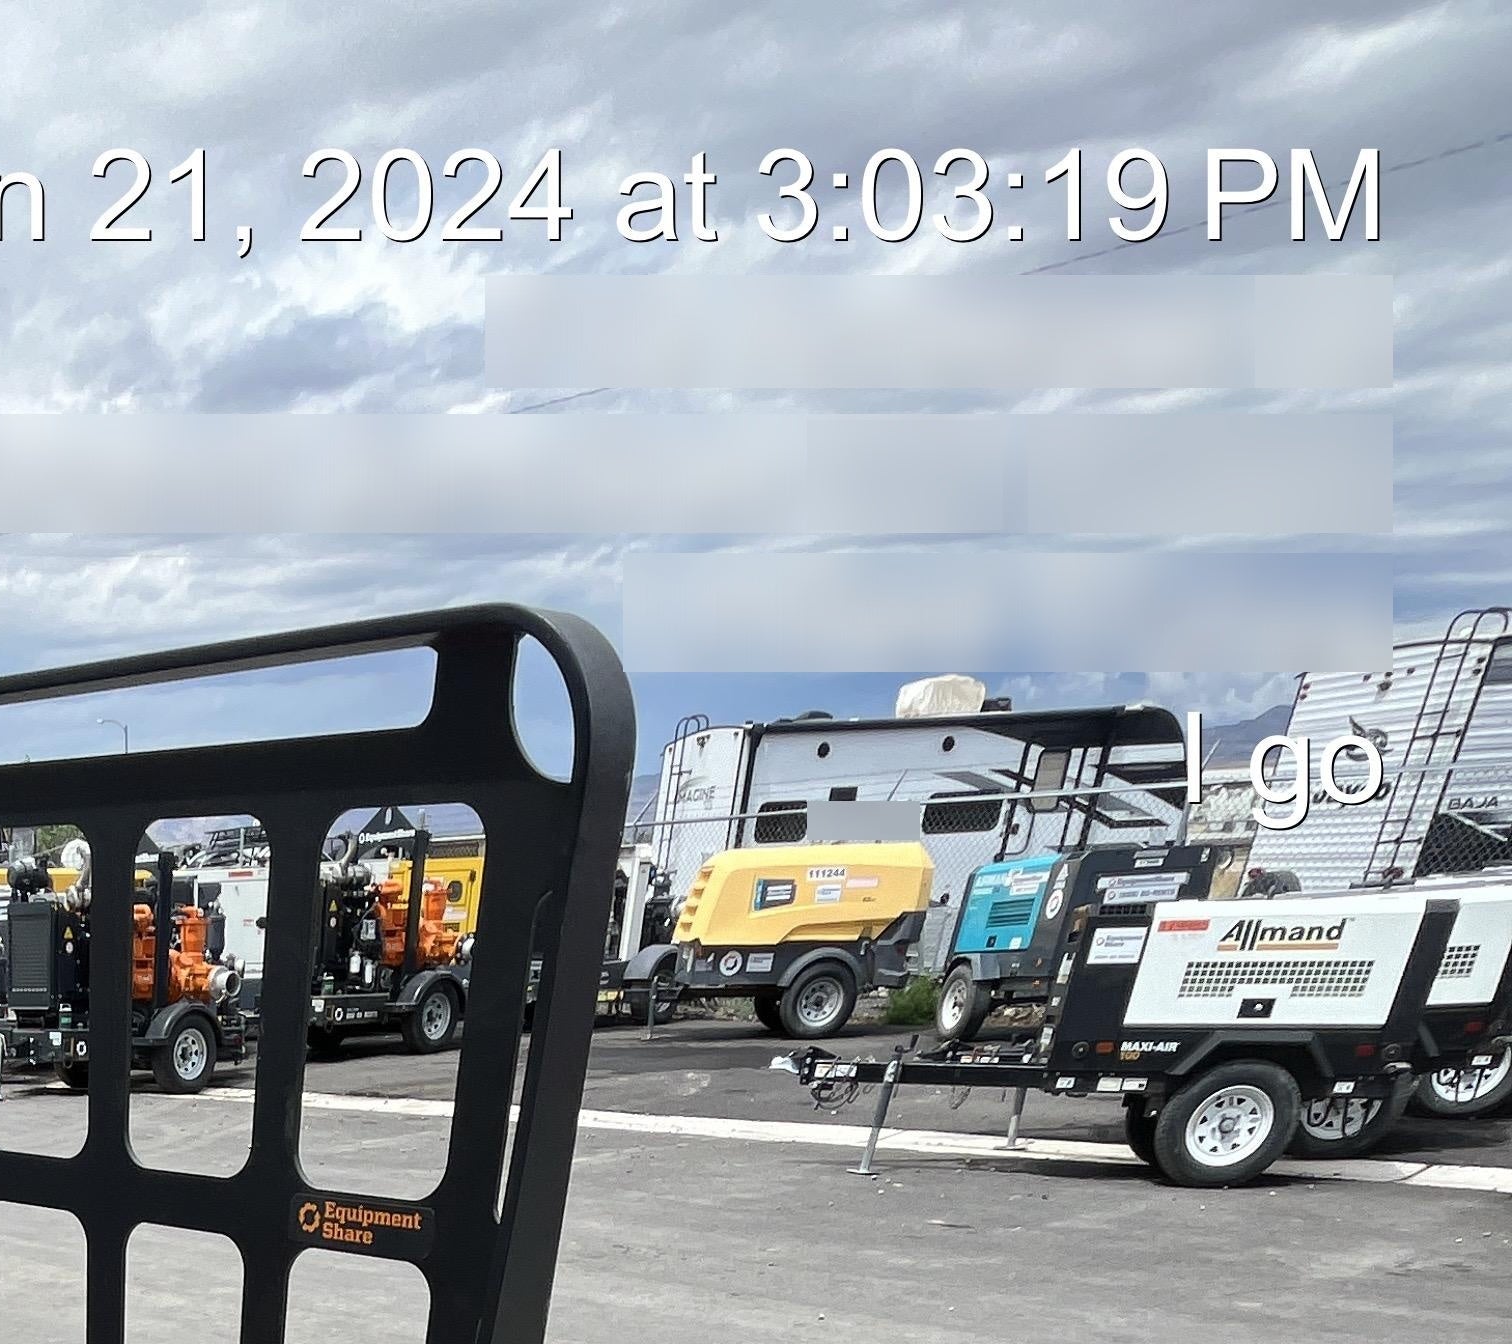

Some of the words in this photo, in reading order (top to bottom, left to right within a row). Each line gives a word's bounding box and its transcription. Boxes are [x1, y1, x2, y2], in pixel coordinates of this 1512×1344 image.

[1449, 796, 1499, 810] BAJA
[808, 867, 846, 879] 111244
[1219, 918, 1348, 951] Allmand
[1120, 1041, 1181, 1053] MAXI-AIR
[324, 1200, 422, 1231] Equipment
[322, 1222, 374, 1245] Share
